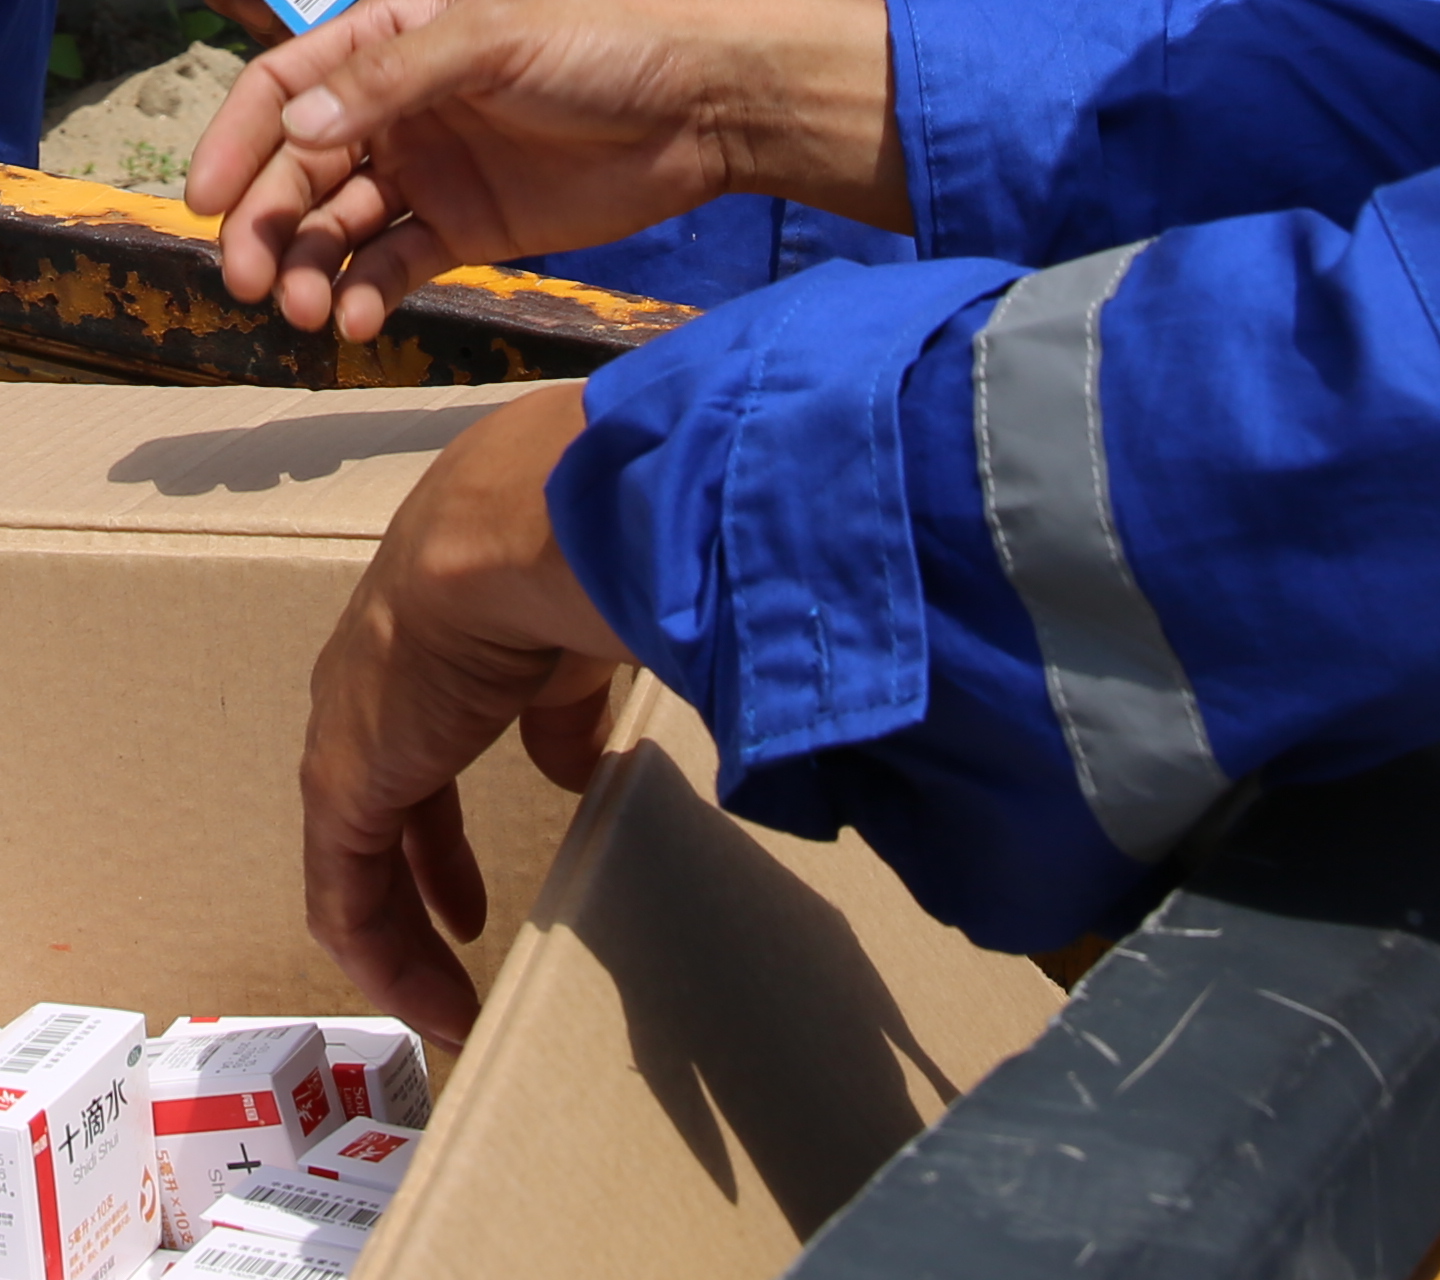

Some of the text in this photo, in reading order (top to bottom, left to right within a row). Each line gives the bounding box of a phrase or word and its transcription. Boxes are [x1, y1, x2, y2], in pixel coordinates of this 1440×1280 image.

[58, 1077, 128, 1164] 十滴水
[72, 1133, 120, 1186] Shidi Shui
